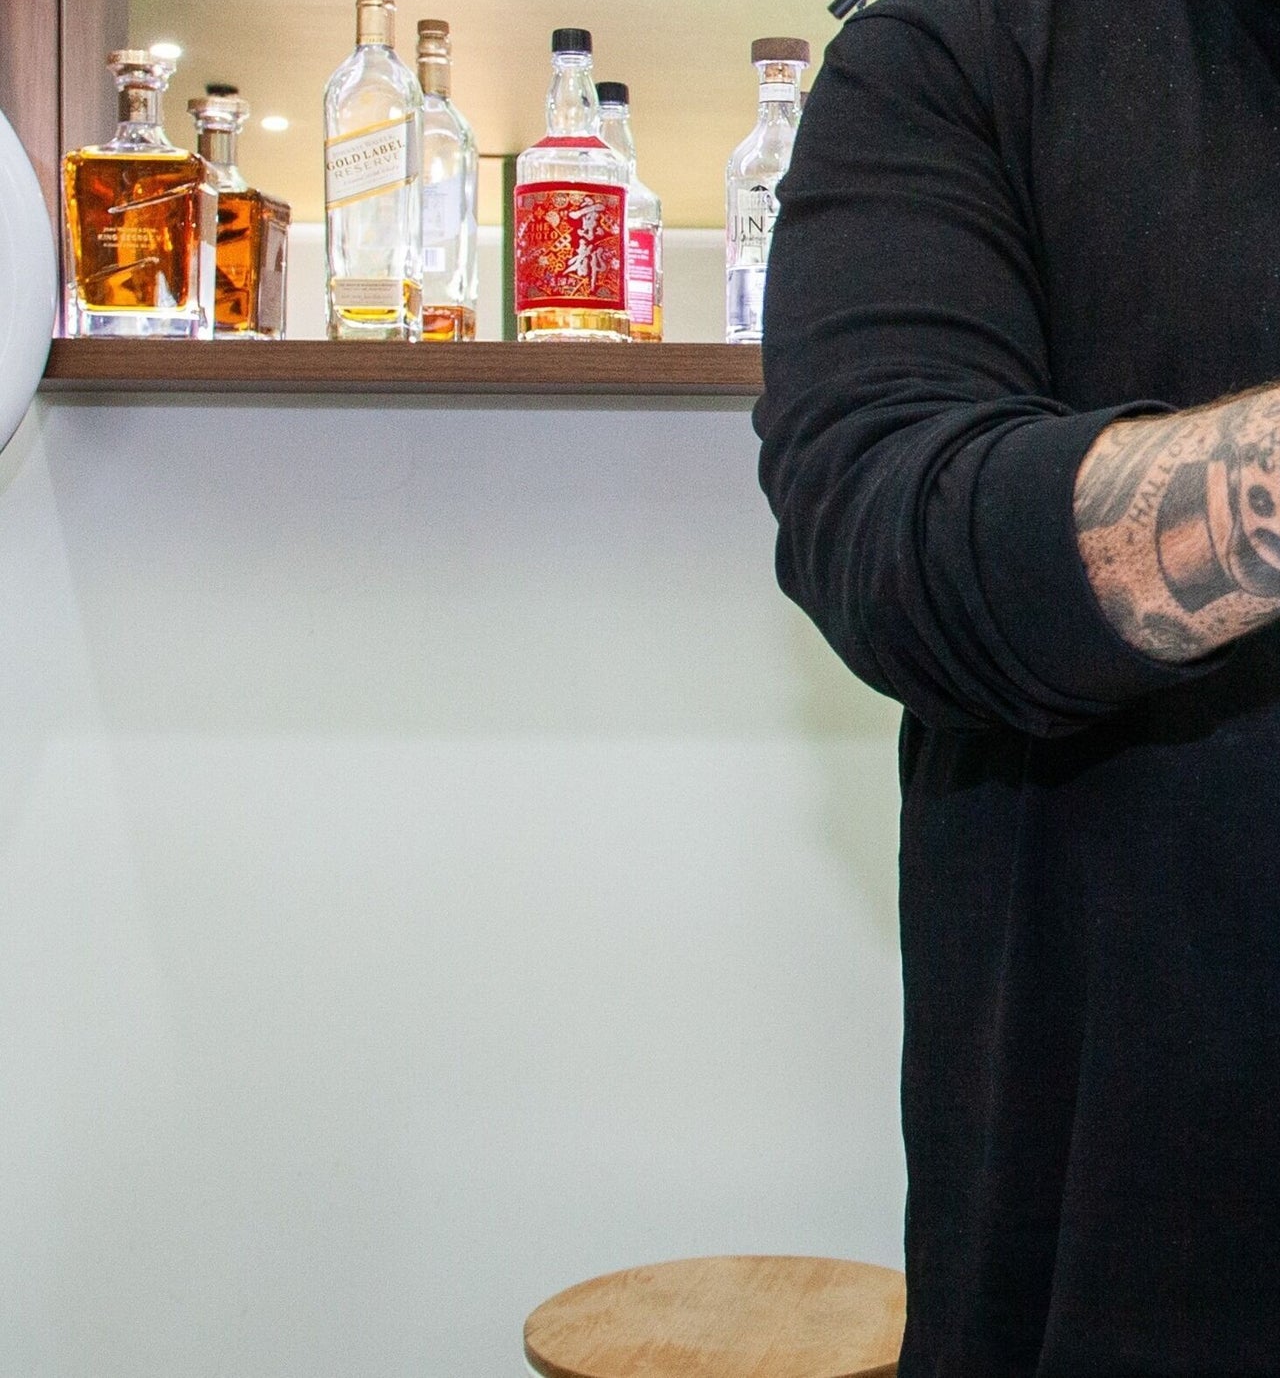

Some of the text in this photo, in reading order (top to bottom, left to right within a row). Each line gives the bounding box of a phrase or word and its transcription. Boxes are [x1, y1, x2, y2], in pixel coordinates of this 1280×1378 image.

[326, 139, 405, 171] GOLD LABEL
[334, 152, 399, 179] RESERVE
[563, 195, 606, 291] 京都
